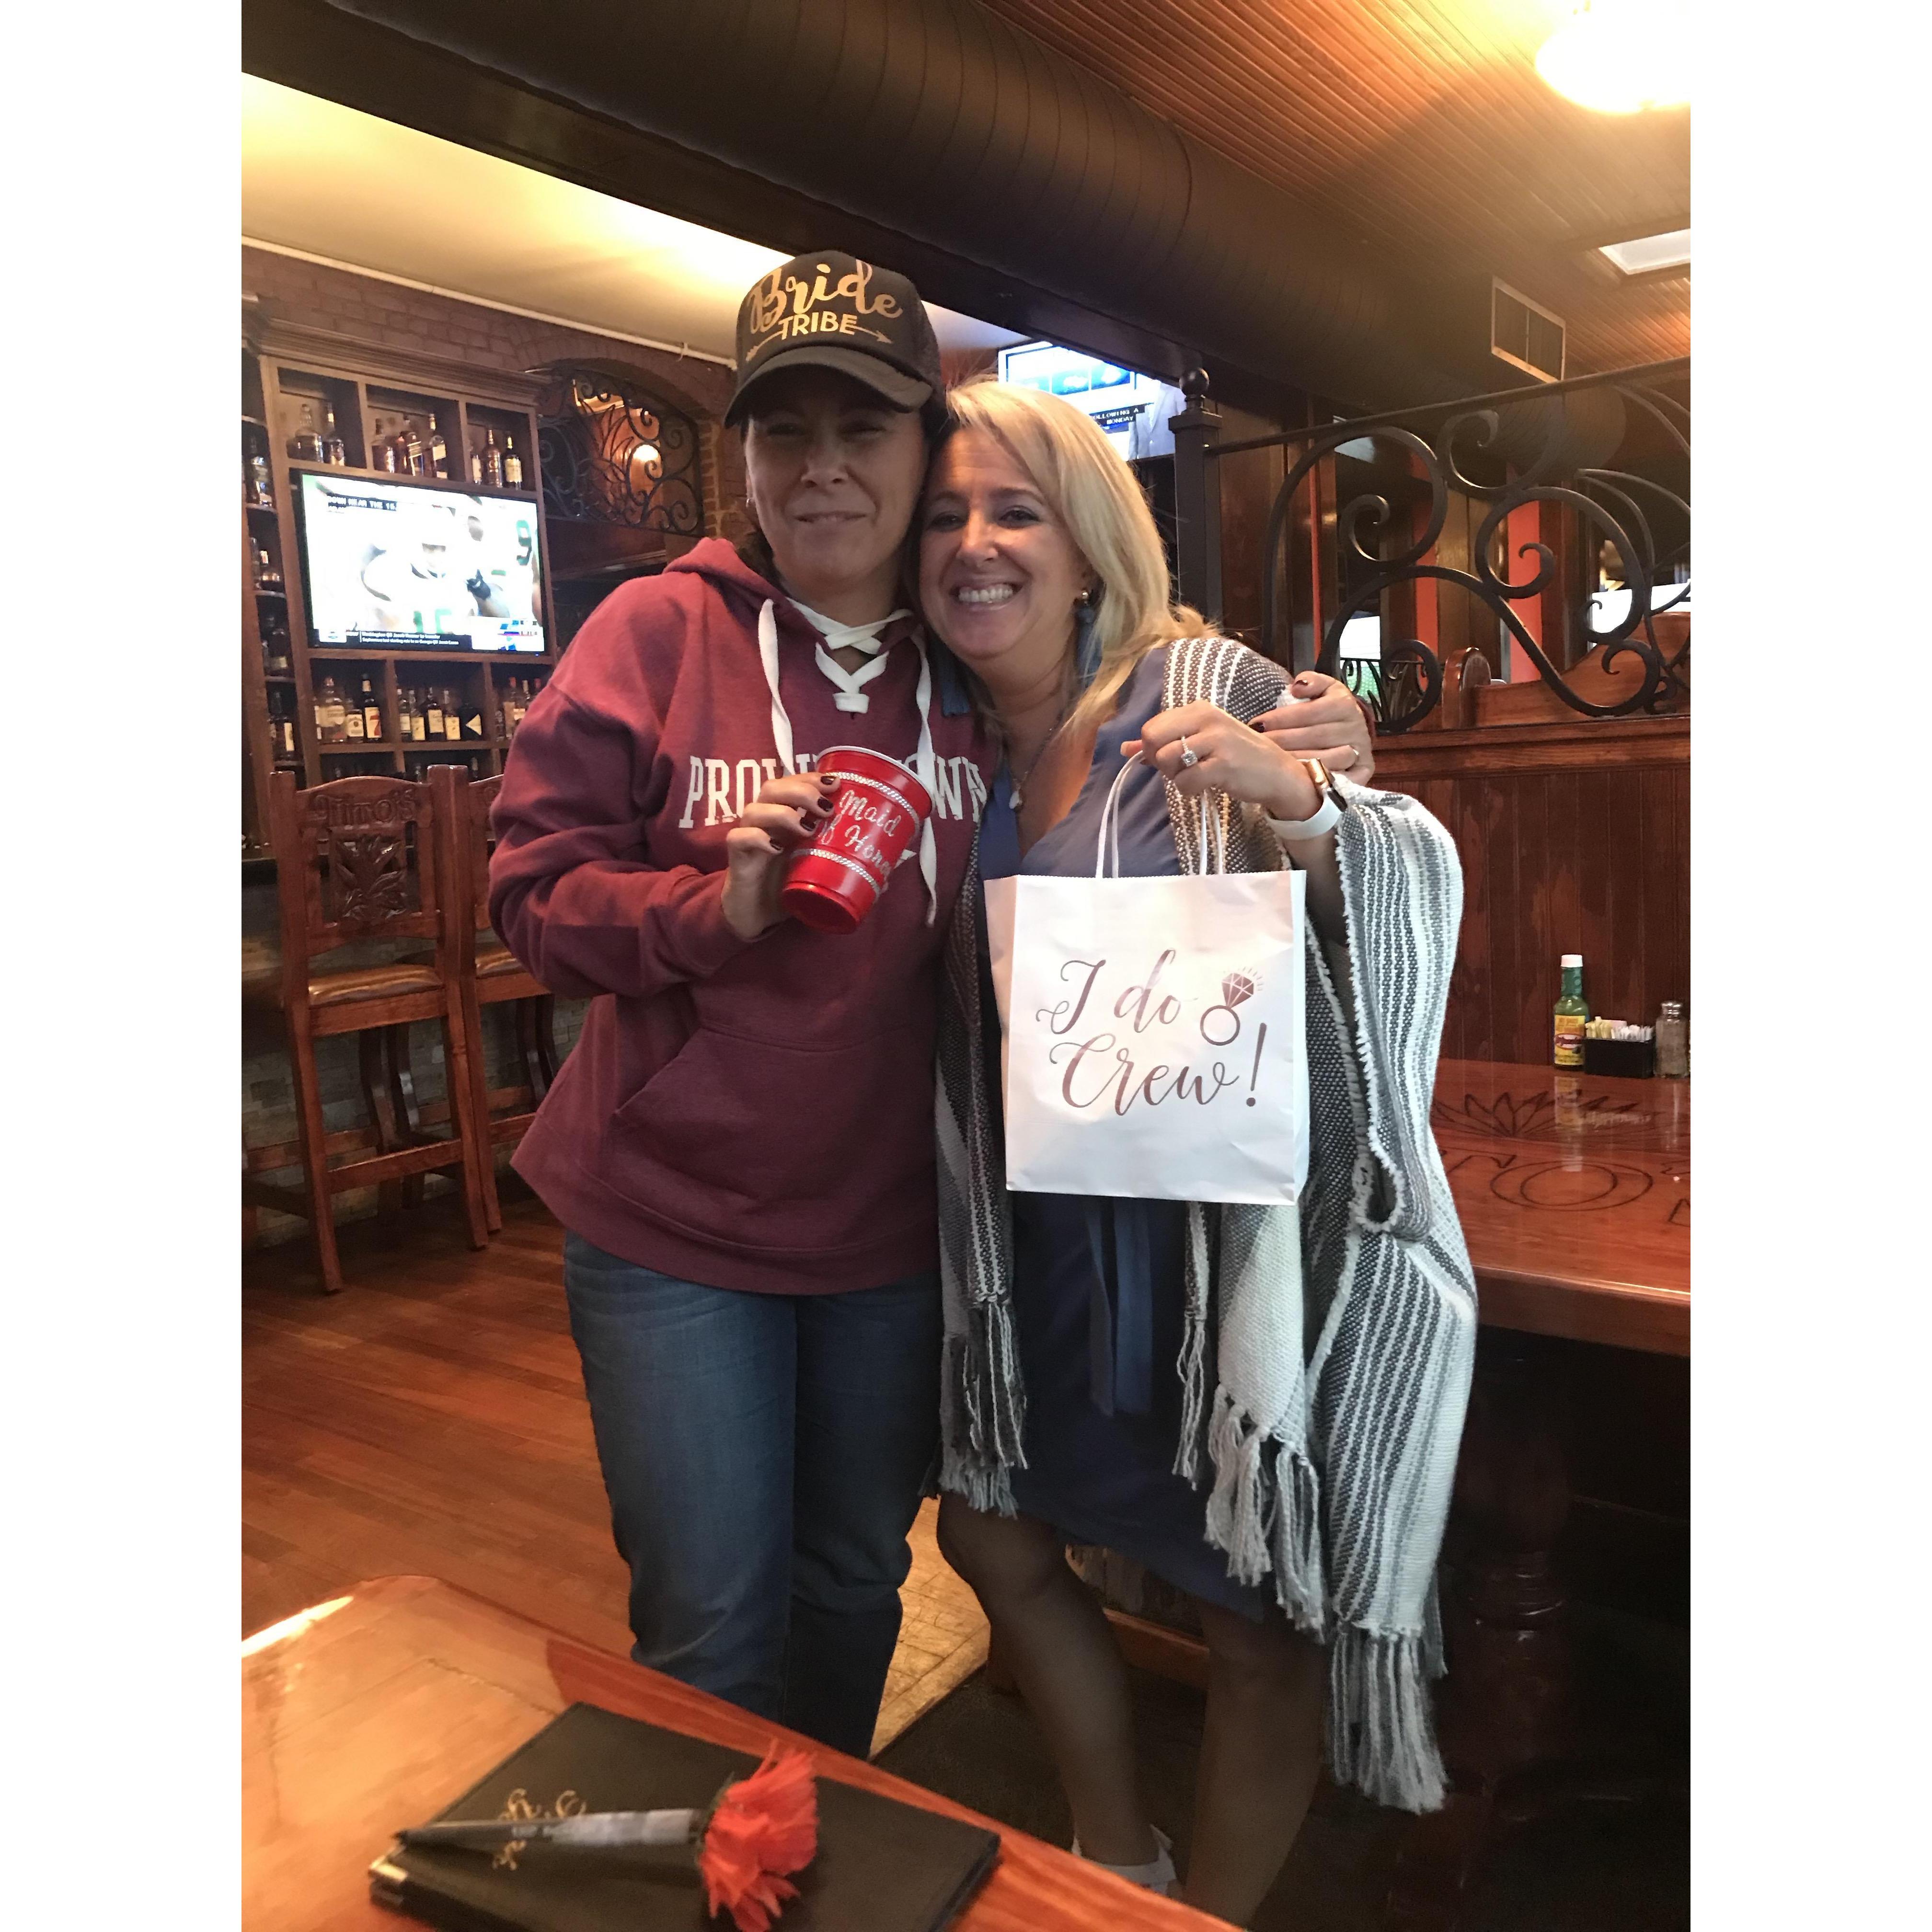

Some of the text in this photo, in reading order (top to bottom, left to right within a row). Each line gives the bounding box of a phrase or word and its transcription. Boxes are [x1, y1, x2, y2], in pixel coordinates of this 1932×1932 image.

[746, 259, 904, 334] Bride
[778, 310, 858, 340] TRIBE
[839, 790, 902, 837] Maid
[1035, 947, 1198, 1035] I do
[1049, 1022, 1267, 1116] Crew!
